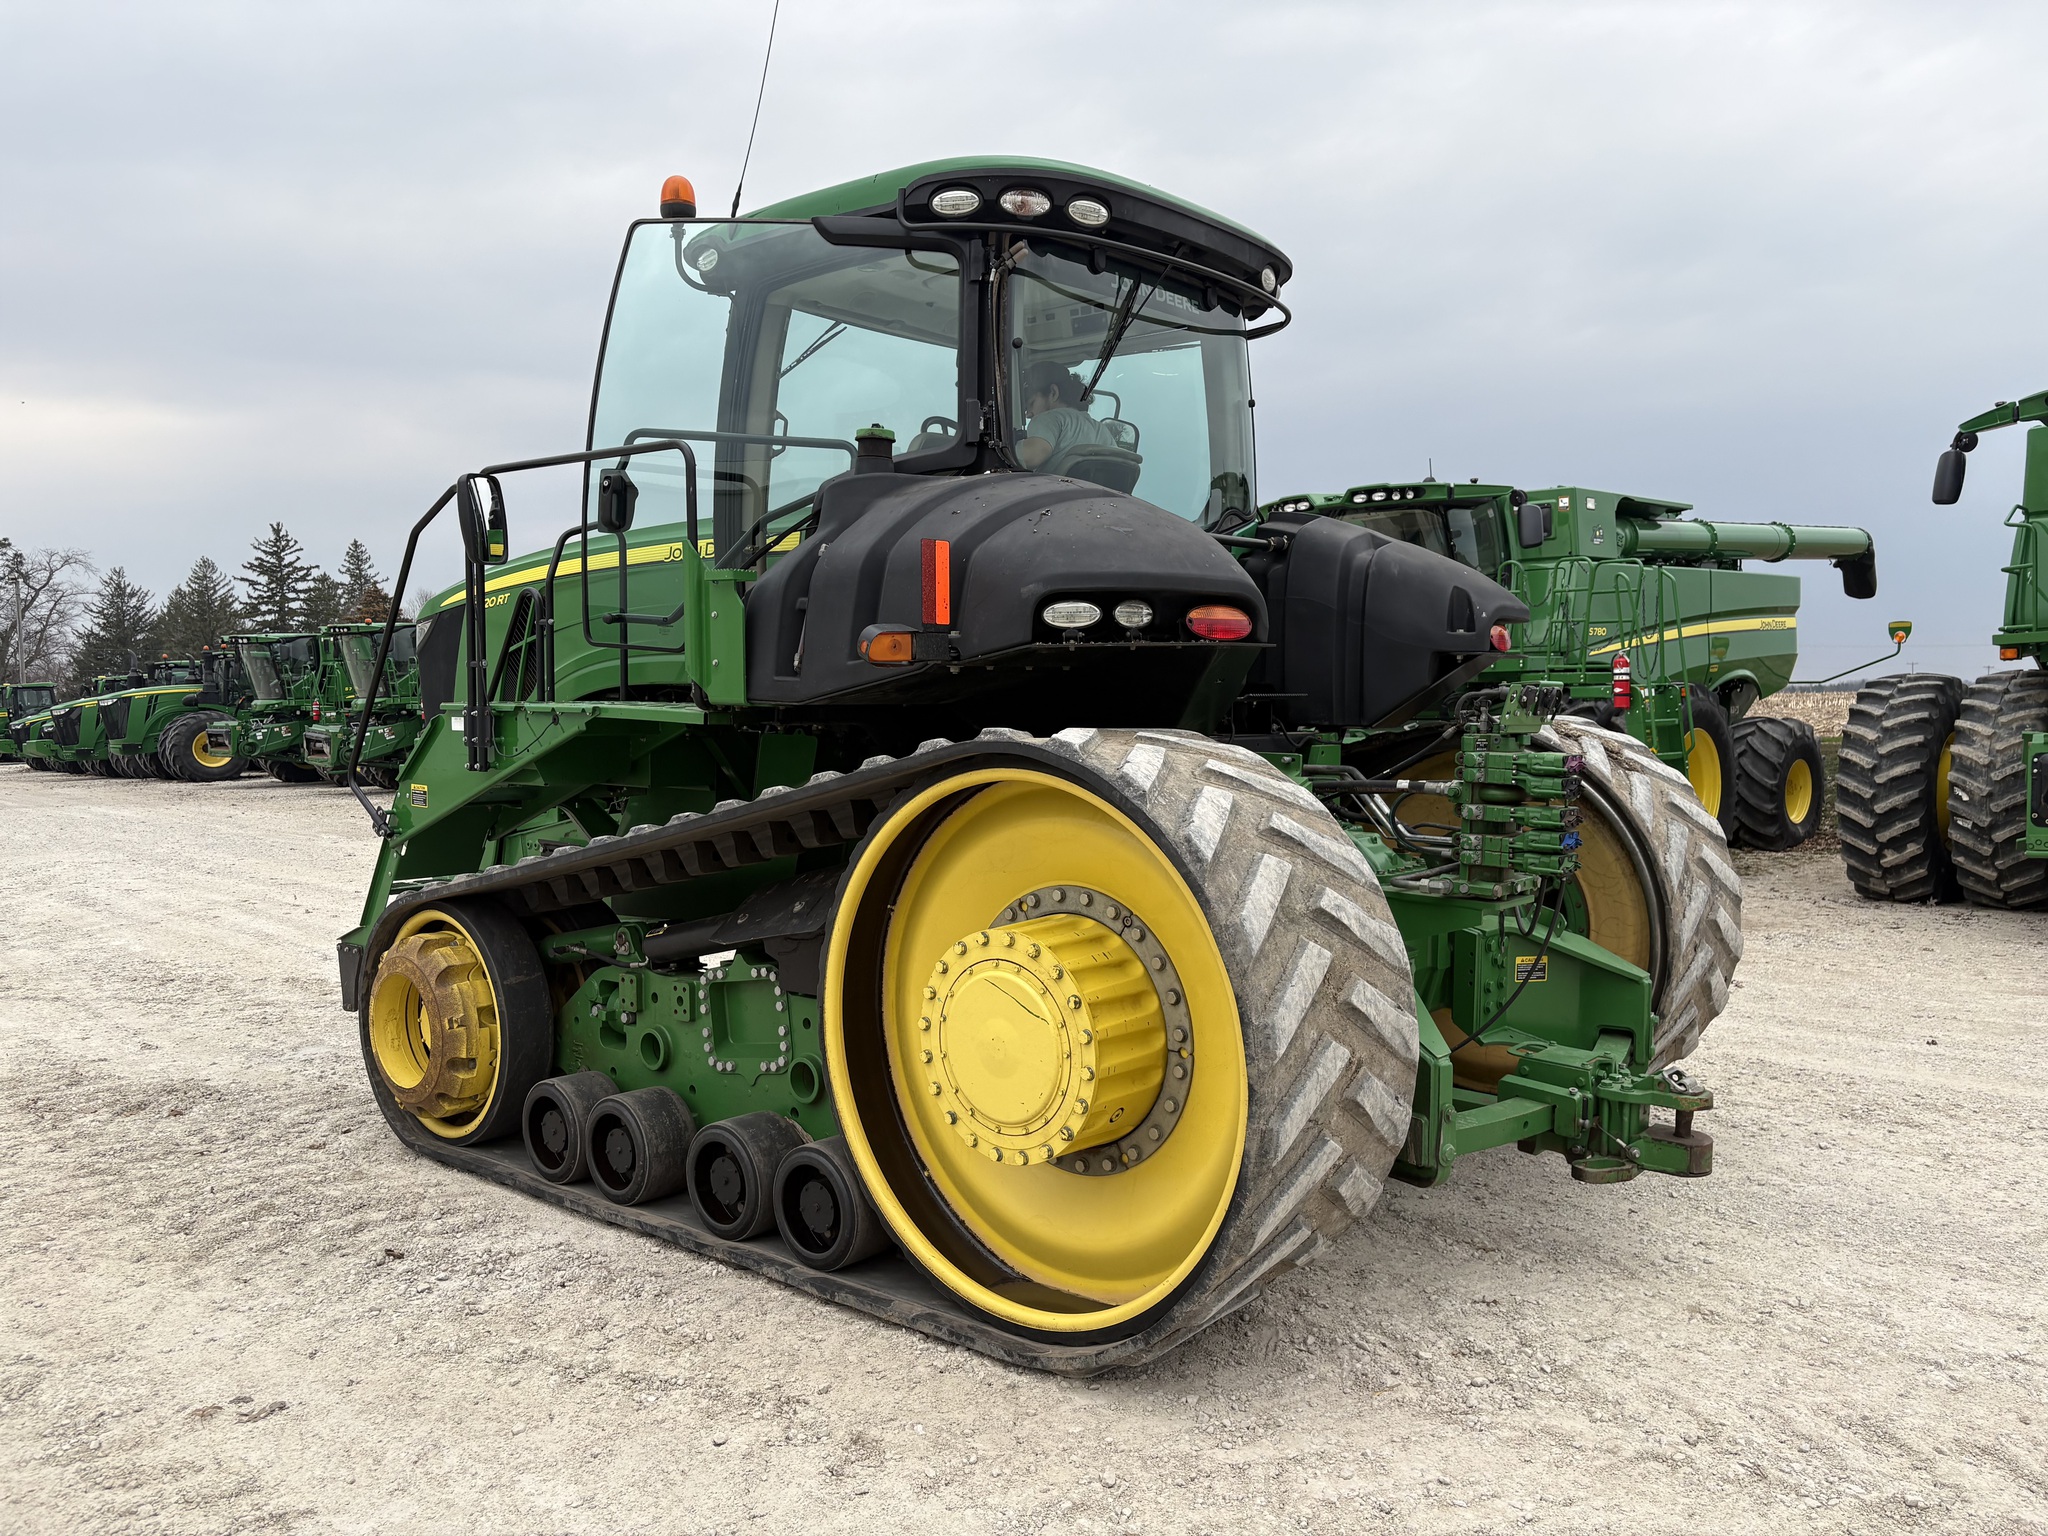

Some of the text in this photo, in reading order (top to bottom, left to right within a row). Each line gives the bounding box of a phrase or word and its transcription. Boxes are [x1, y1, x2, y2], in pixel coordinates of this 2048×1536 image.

[1111, 271, 1200, 315] JON DEERE
[1760, 619, 1787, 630] JOHN DEERE
[1588, 627, 1607, 636] S780
